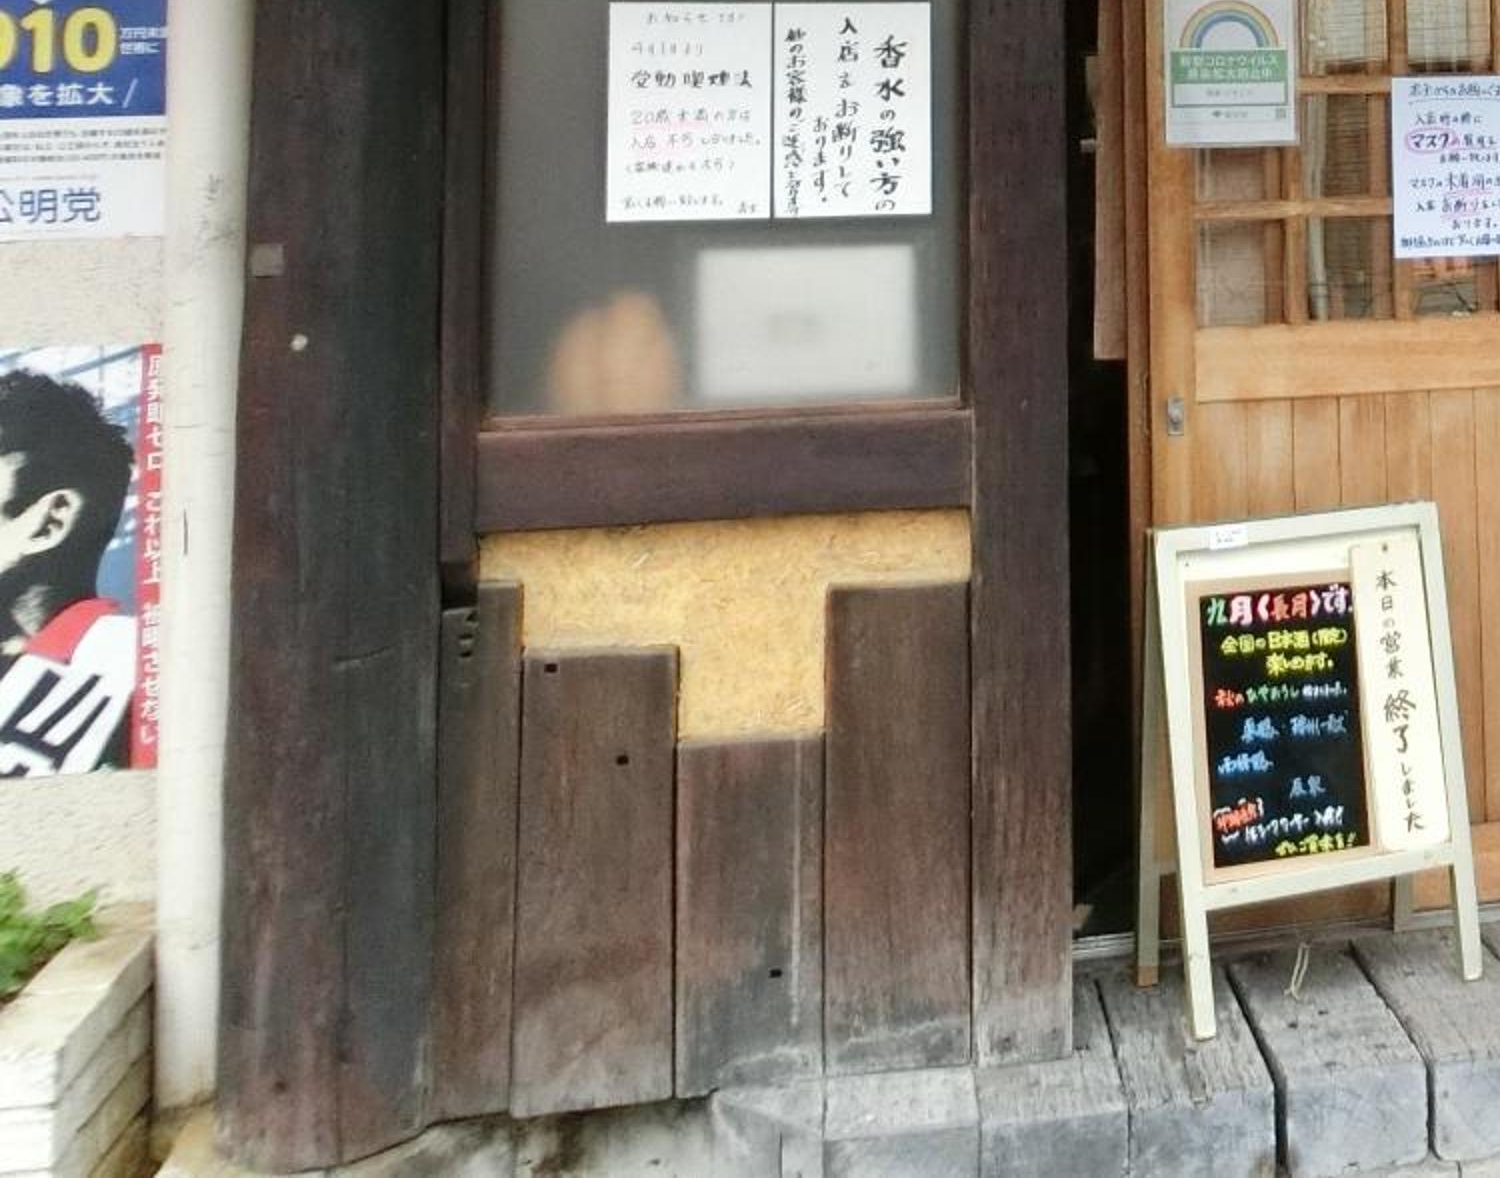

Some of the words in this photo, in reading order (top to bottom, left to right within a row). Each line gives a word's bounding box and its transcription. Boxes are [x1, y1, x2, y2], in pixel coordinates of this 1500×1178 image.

[869, 34, 907, 211] 香水の強い方の
[1376, 569, 1426, 833] 本日の営業終了しました
